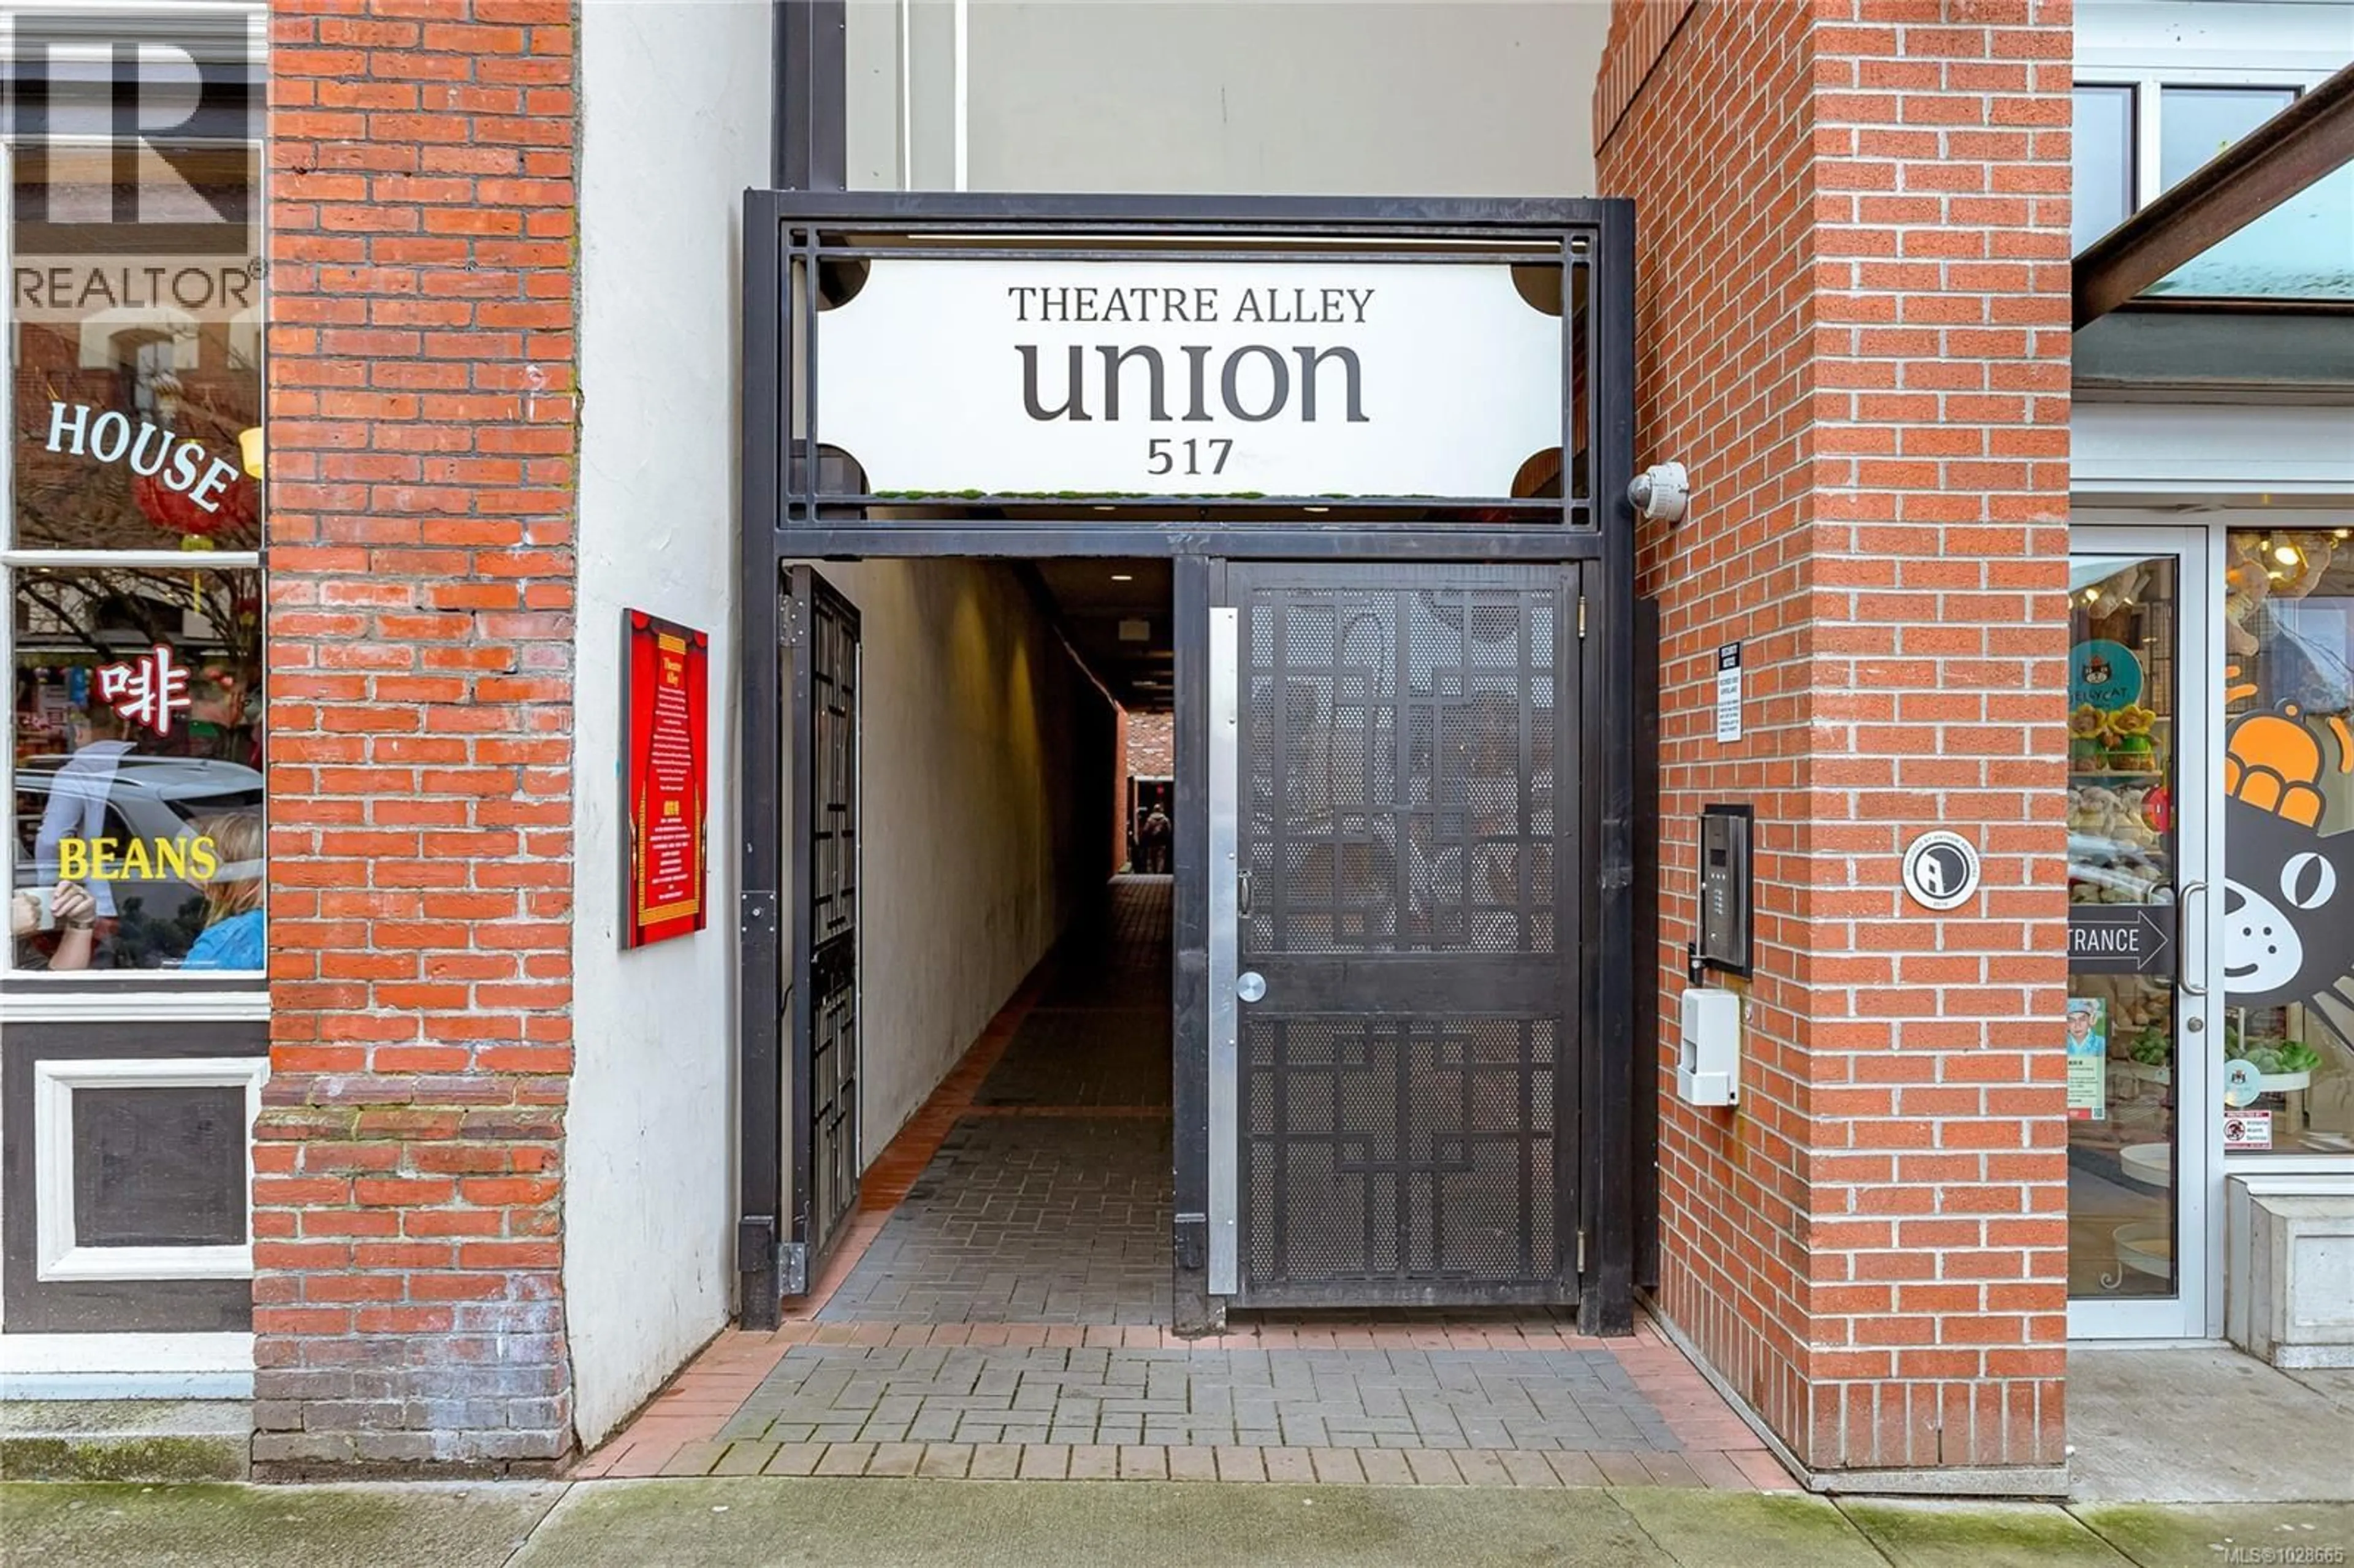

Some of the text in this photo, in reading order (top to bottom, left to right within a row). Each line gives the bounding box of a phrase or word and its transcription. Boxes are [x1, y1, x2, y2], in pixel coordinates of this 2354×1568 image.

[1008, 287, 1375, 323] THEATRE ALLEY
[45, 402, 240, 513] HOUSE
[1147, 438, 1233, 475] 517
[99, 647, 191, 733] 啡
[59, 837, 216, 880] BEANS
